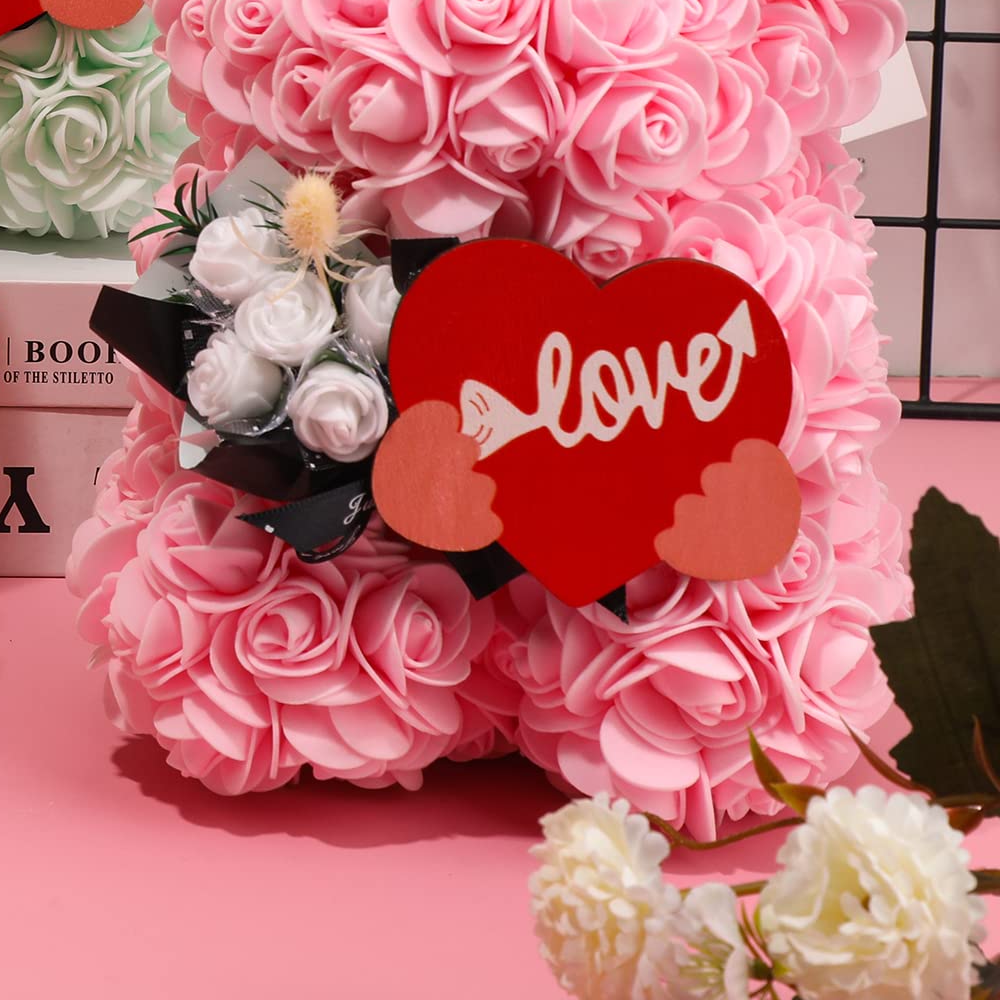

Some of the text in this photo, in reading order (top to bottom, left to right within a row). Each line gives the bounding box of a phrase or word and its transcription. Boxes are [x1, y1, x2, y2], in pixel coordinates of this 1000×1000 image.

[3, 371, 20, 383] OF
[24, 371, 48, 383] THE
[53, 371, 114, 384] STILETTO
[535, 331, 740, 449] love
